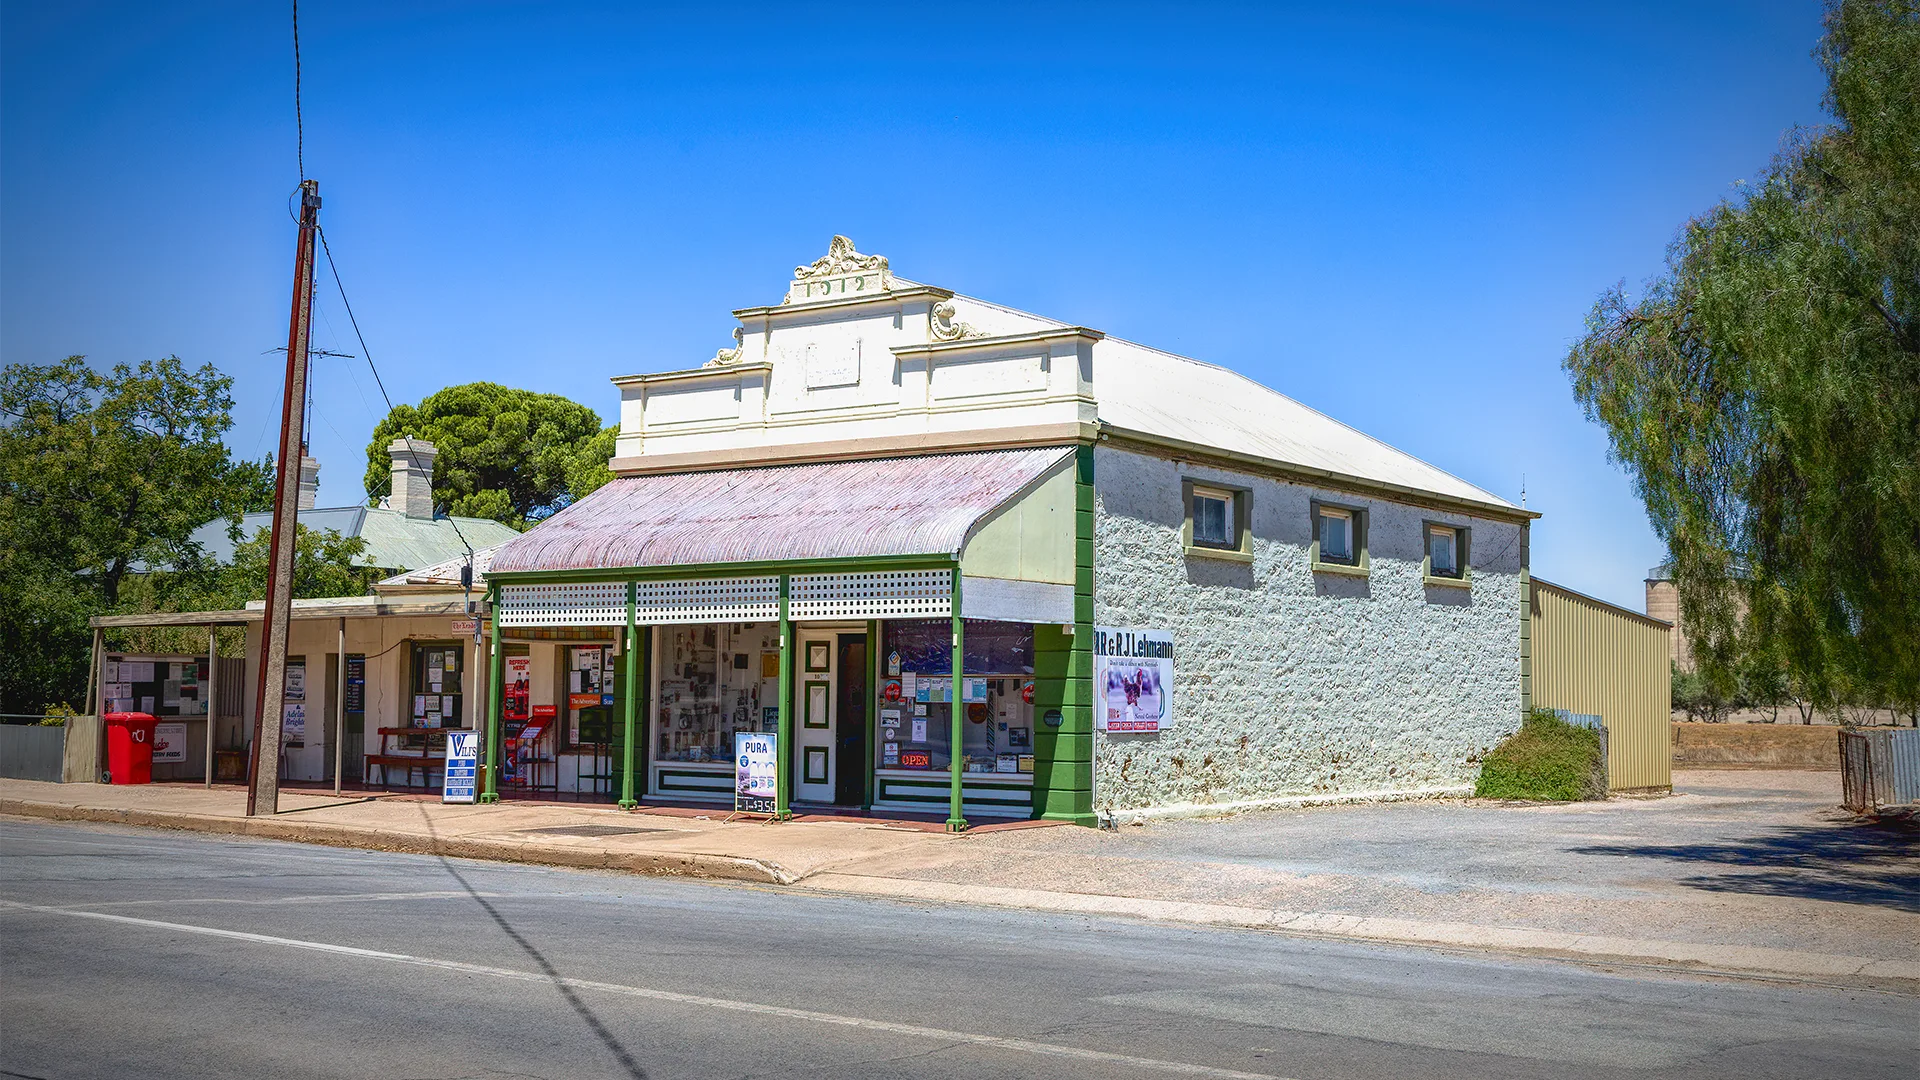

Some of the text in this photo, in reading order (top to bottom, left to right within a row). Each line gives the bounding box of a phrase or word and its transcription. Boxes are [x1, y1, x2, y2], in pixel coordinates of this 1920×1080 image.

[804, 275, 865, 298] 1912
[1132, 633, 1173, 659] Lehmann
[745, 742, 768, 753] PURA
[901, 755, 929, 766] OPEN
